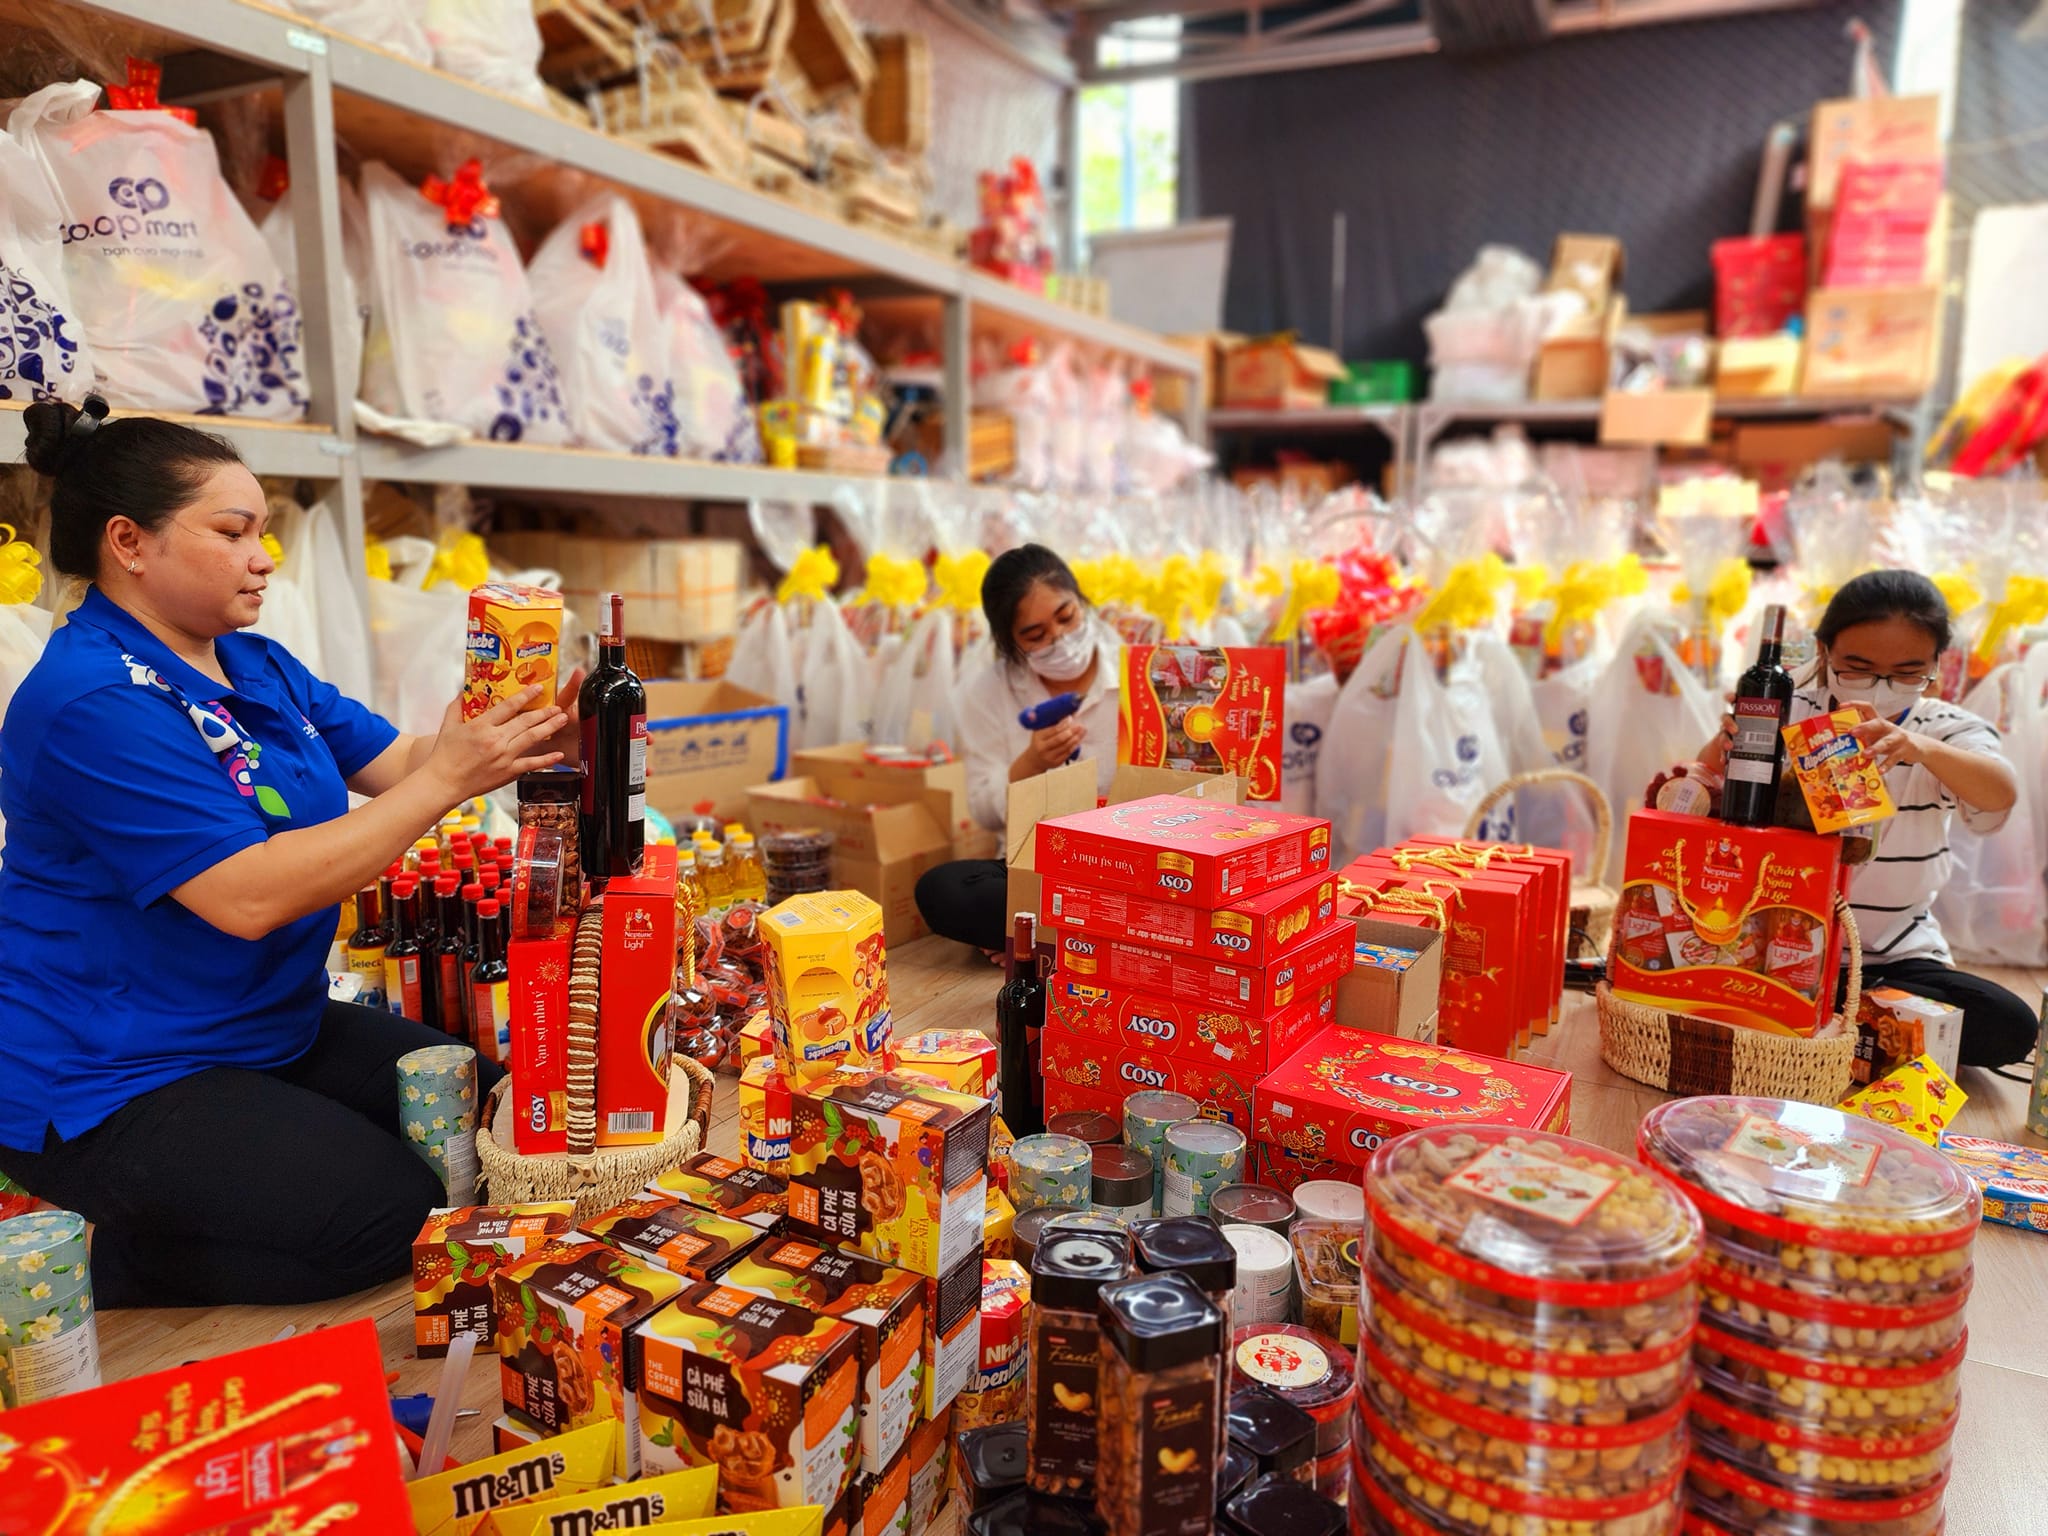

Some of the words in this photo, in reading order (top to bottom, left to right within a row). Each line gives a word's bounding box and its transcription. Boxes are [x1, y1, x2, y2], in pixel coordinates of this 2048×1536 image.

[1740, 702, 1776, 714] PASSION
[1804, 736, 1852, 770] Alpenliebe
[1310, 846, 1327, 862] COSY
[1703, 866, 1742, 879] Neptune
[1156, 873, 1193, 893] COSY
[1701, 878, 1729, 893] Light
[624, 930, 653, 938] Neptune
[1212, 932, 1250, 952] COSY
[624, 940, 644, 950] Light
[1065, 937, 1096, 955] COSY
[1773, 947, 1800, 963] Light
[1276, 967, 1295, 986] COSY
[1126, 1014, 1176, 1041] COSY
[807, 1040, 848, 1060] Alpenliebe
[1120, 1062, 1168, 1088] COSY
[1364, 1071, 1462, 1098] COSY
[531, 1094, 547, 1133] COSY
[821, 1186, 838, 1213] PHÊ
[839, 1189, 857, 1209] ĐÁ
[821, 1216, 838, 1231] CÀ
[838, 1213, 856, 1238] SỮA
[811, 1262, 830, 1274] SỮA
[831, 1267, 846, 1278] ĐÁ
[820, 1255, 833, 1265] CÀ
[831, 1256, 853, 1269] PHÊ
[739, 1311, 759, 1323] SỮA
[758, 1316, 777, 1329] ĐÁ
[750, 1302, 764, 1313] CÀ
[762, 1304, 787, 1319] PHÊ
[452, 1328, 468, 1337] À
[985, 1335, 1019, 1364] Nhà
[1048, 1346, 1098, 1362] Finest
[647, 1360, 664, 1372] THE
[525, 1371, 539, 1400] PHÊ
[540, 1377, 554, 1397] ĐÁ
[647, 1367, 681, 1387] COFFEE
[686, 1367, 702, 1389] CÀ
[703, 1372, 725, 1393] PHÊ
[647, 1378, 676, 1397] HOUSE
[526, 1400, 541, 1418] CÀ
[540, 1398, 557, 1427] SỮA
[686, 1388, 710, 1412] SỮA
[711, 1396, 729, 1418] ĐÁ
[1154, 1402, 1204, 1426] Finest
[195, 1452, 241, 1499] Light
[250, 1441, 274, 1503] Neptune
